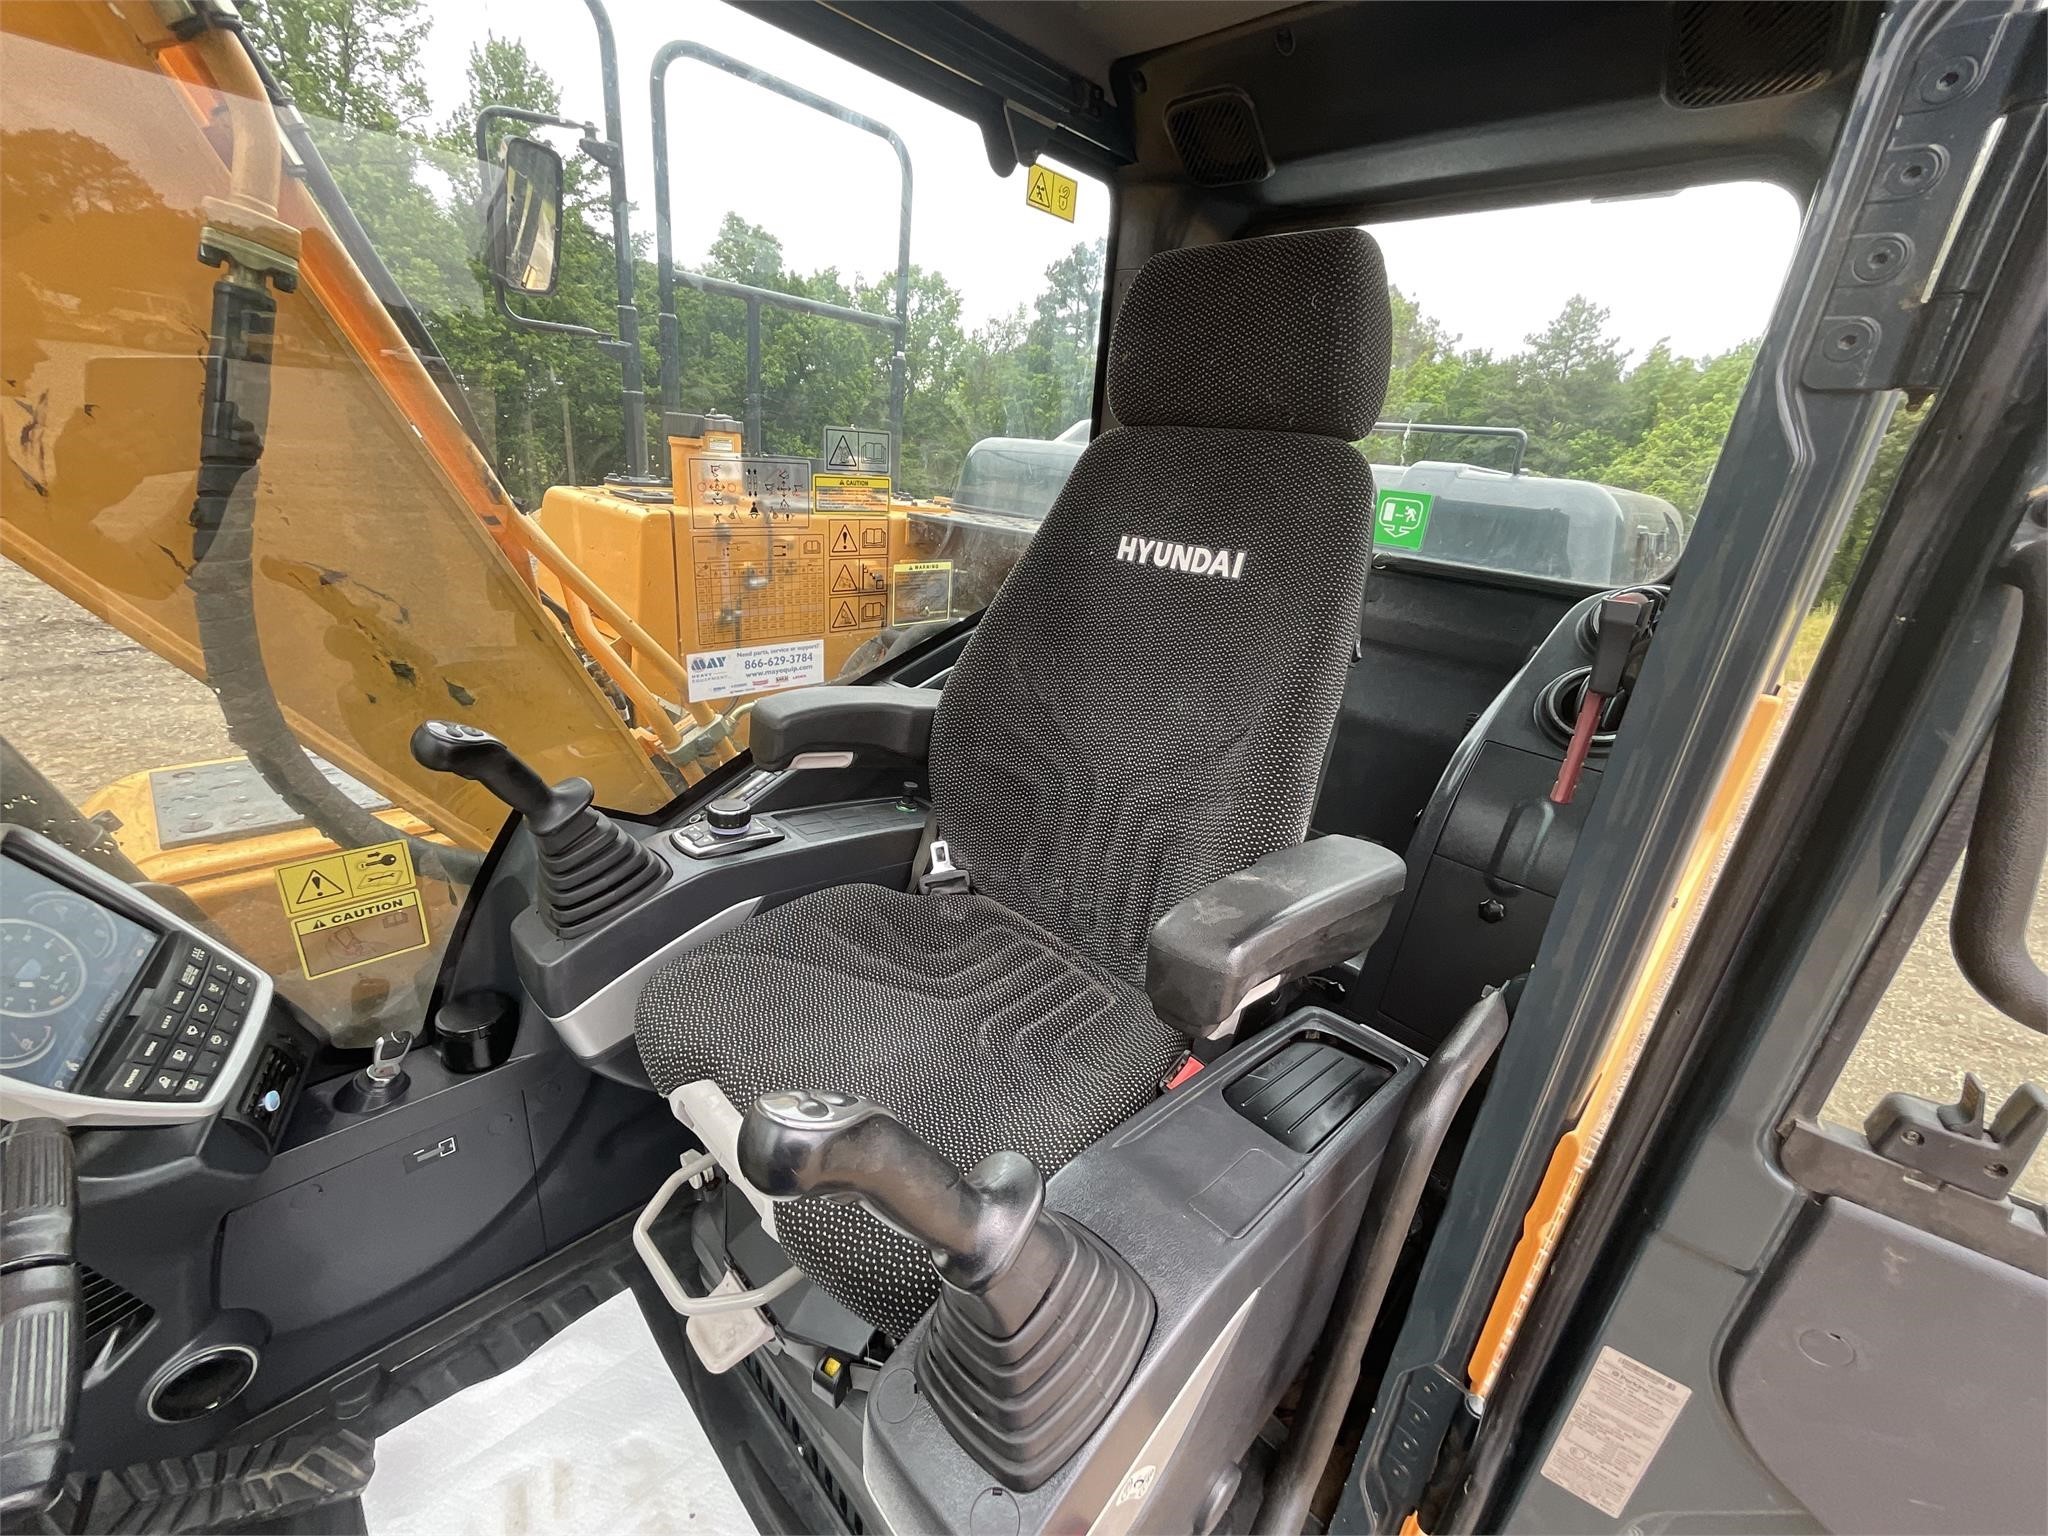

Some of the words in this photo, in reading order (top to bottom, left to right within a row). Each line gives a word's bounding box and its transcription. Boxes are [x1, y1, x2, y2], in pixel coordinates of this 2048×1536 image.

[1117, 535, 1245, 579] HYUNDAI
[797, 643, 820, 652] support?
[691, 656, 726, 671] MAY
[744, 653, 813, 670] 866-629-3784
[745, 665, 813, 678] www.mayequip.com
[331, 899, 404, 924] CAUTION
[123, 1068, 141, 1088] POWER
